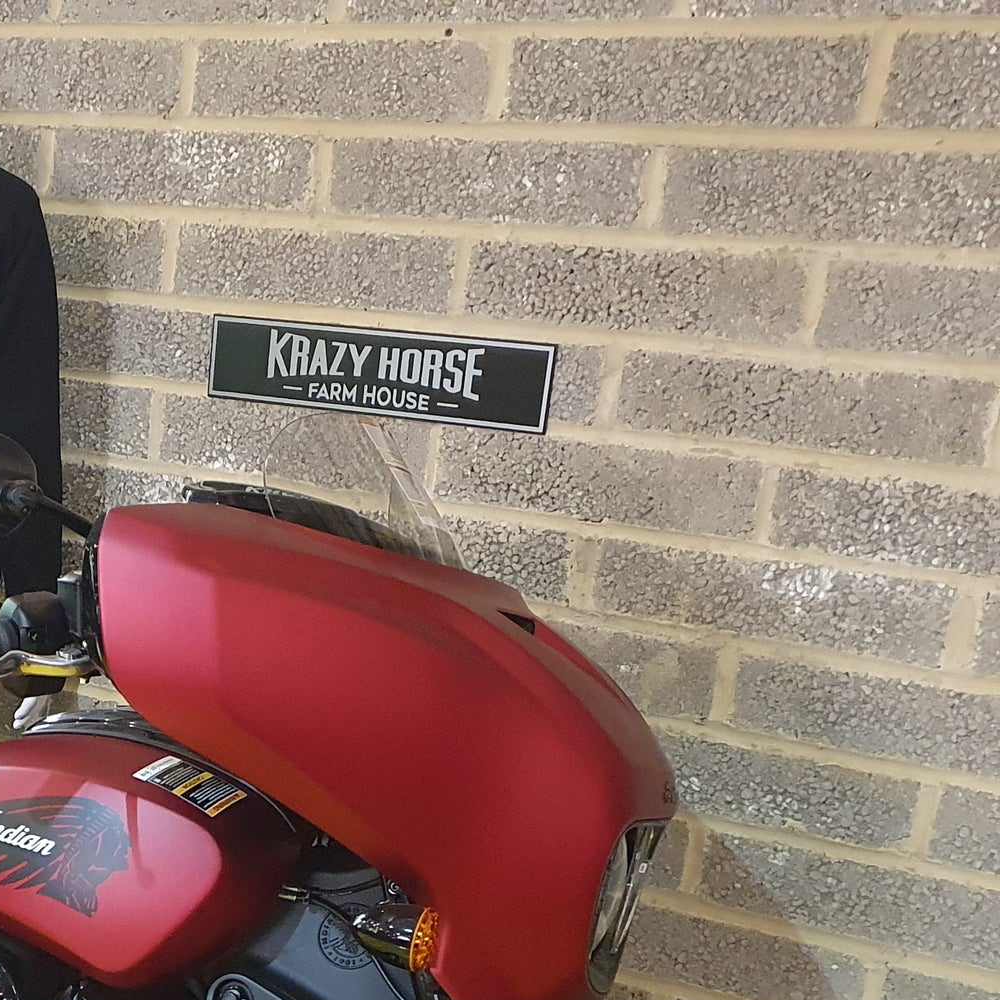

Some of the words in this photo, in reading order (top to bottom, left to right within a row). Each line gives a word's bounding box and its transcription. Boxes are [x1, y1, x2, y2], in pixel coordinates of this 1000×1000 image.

[266, 328, 373, 380] KRAZY
[377, 347, 486, 401] HORSE
[308, 382, 357, 402] FARM
[362, 385, 430, 411] HOUSE
